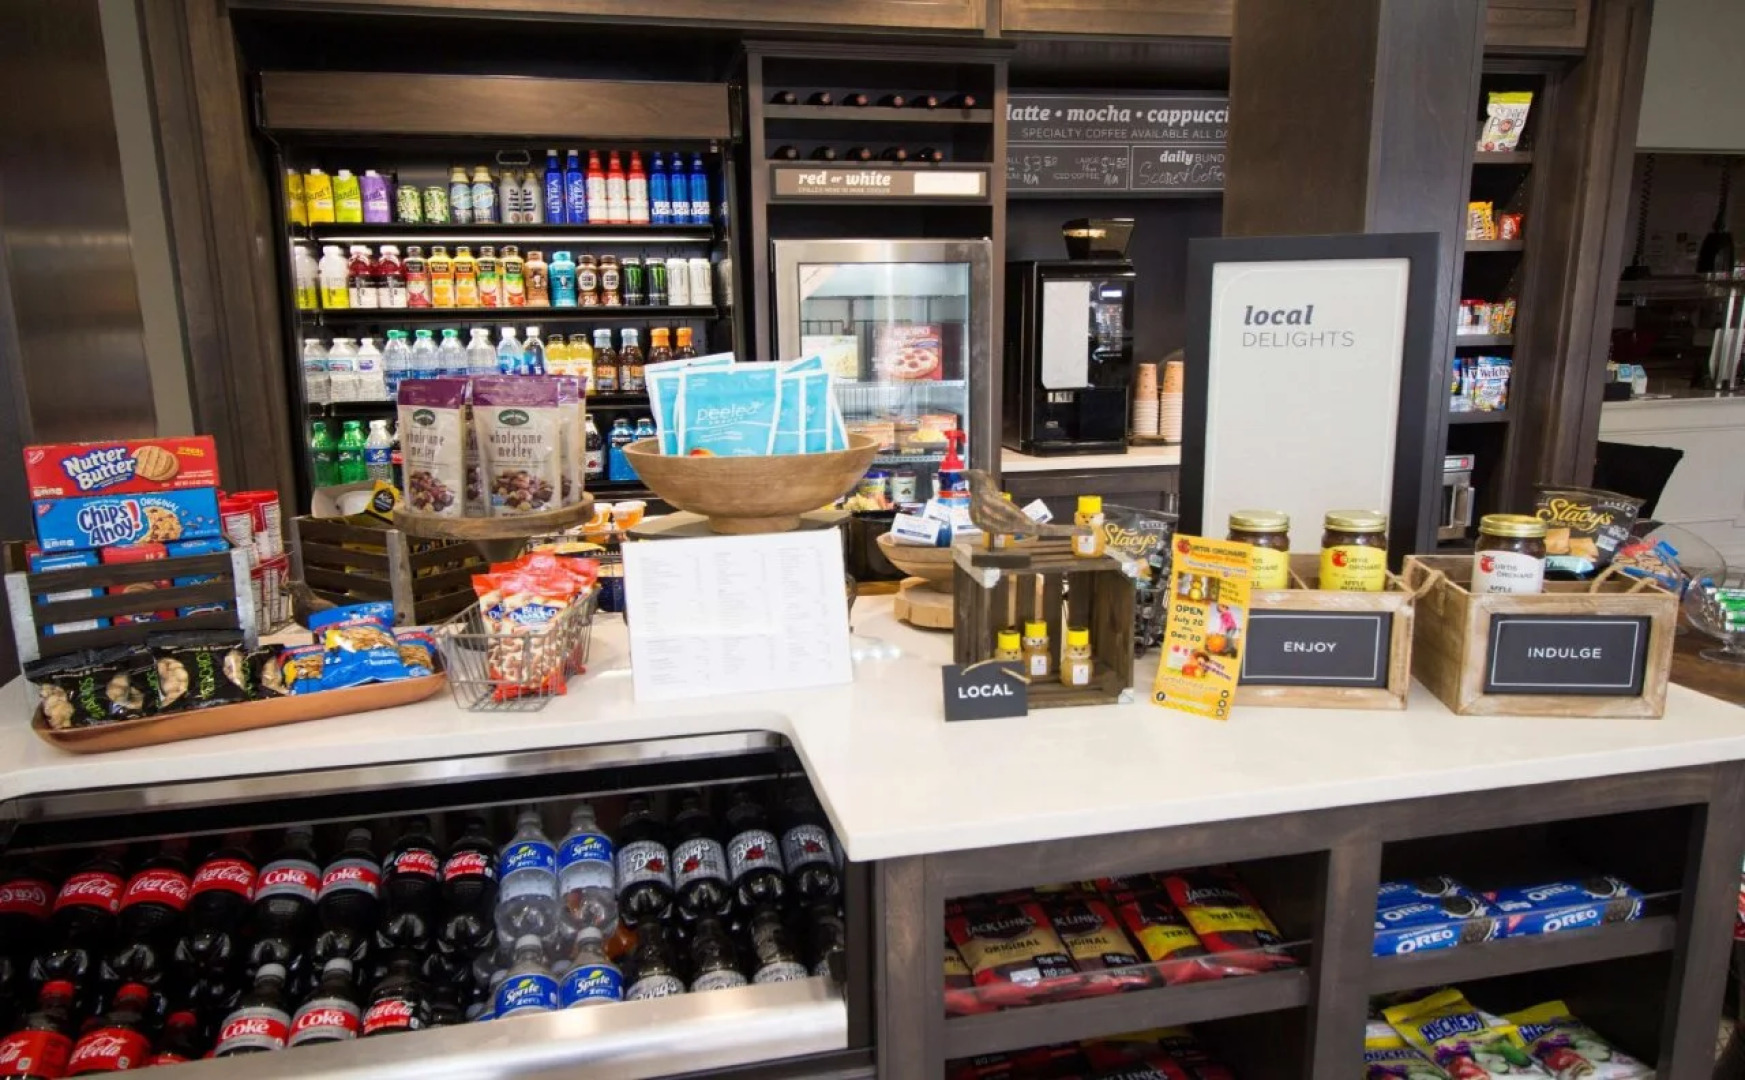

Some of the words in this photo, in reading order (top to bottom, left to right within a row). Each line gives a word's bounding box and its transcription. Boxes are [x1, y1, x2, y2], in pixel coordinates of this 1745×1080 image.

[1006, 104, 1051, 121] latte
[1067, 105, 1131, 122] mocha
[1022, 128, 1082, 139] SPECIALTY
[1085, 128, 1127, 138] COFFEE
[1130, 129, 1189, 139] AVAILABLE
[1192, 129, 1212, 139] ALL
[1159, 150, 1193, 166] daily
[798, 170, 827, 185] red
[845, 171, 892, 186] white
[1244, 304, 1314, 326] local
[1242, 331, 1355, 347] DELIGHTS
[488, 430, 543, 445] wholesome
[498, 445, 532, 459] medley
[62, 447, 127, 478] Nutter
[75, 458, 136, 491] Butter
[1175, 604, 1204, 616] OPEN
[1174, 615, 1190, 625] July
[1193, 619, 1203, 627] 20
[1283, 641, 1337, 653] ENJOY
[1528, 647, 1602, 659] INDULGE
[958, 683, 1014, 700] LOCAL
[506, 849, 538, 868] Sprite
[572, 843, 601, 857] Sprite
[264, 868, 308, 886] Coke
[322, 867, 362, 886] Coke
[130, 877, 189, 899] Coca-Cola
[1527, 884, 1576, 901] OREO
[1383, 903, 1435, 921] OREO
[1543, 909, 1598, 933] OREO
[984, 937, 1041, 954] ORIGINAL
[1395, 928, 1454, 955] OREO
[575, 974, 611, 996] Sprite
[506, 982, 540, 1007] Sprite
[298, 1009, 346, 1028] Coke
[222, 1019, 270, 1041] Coke
